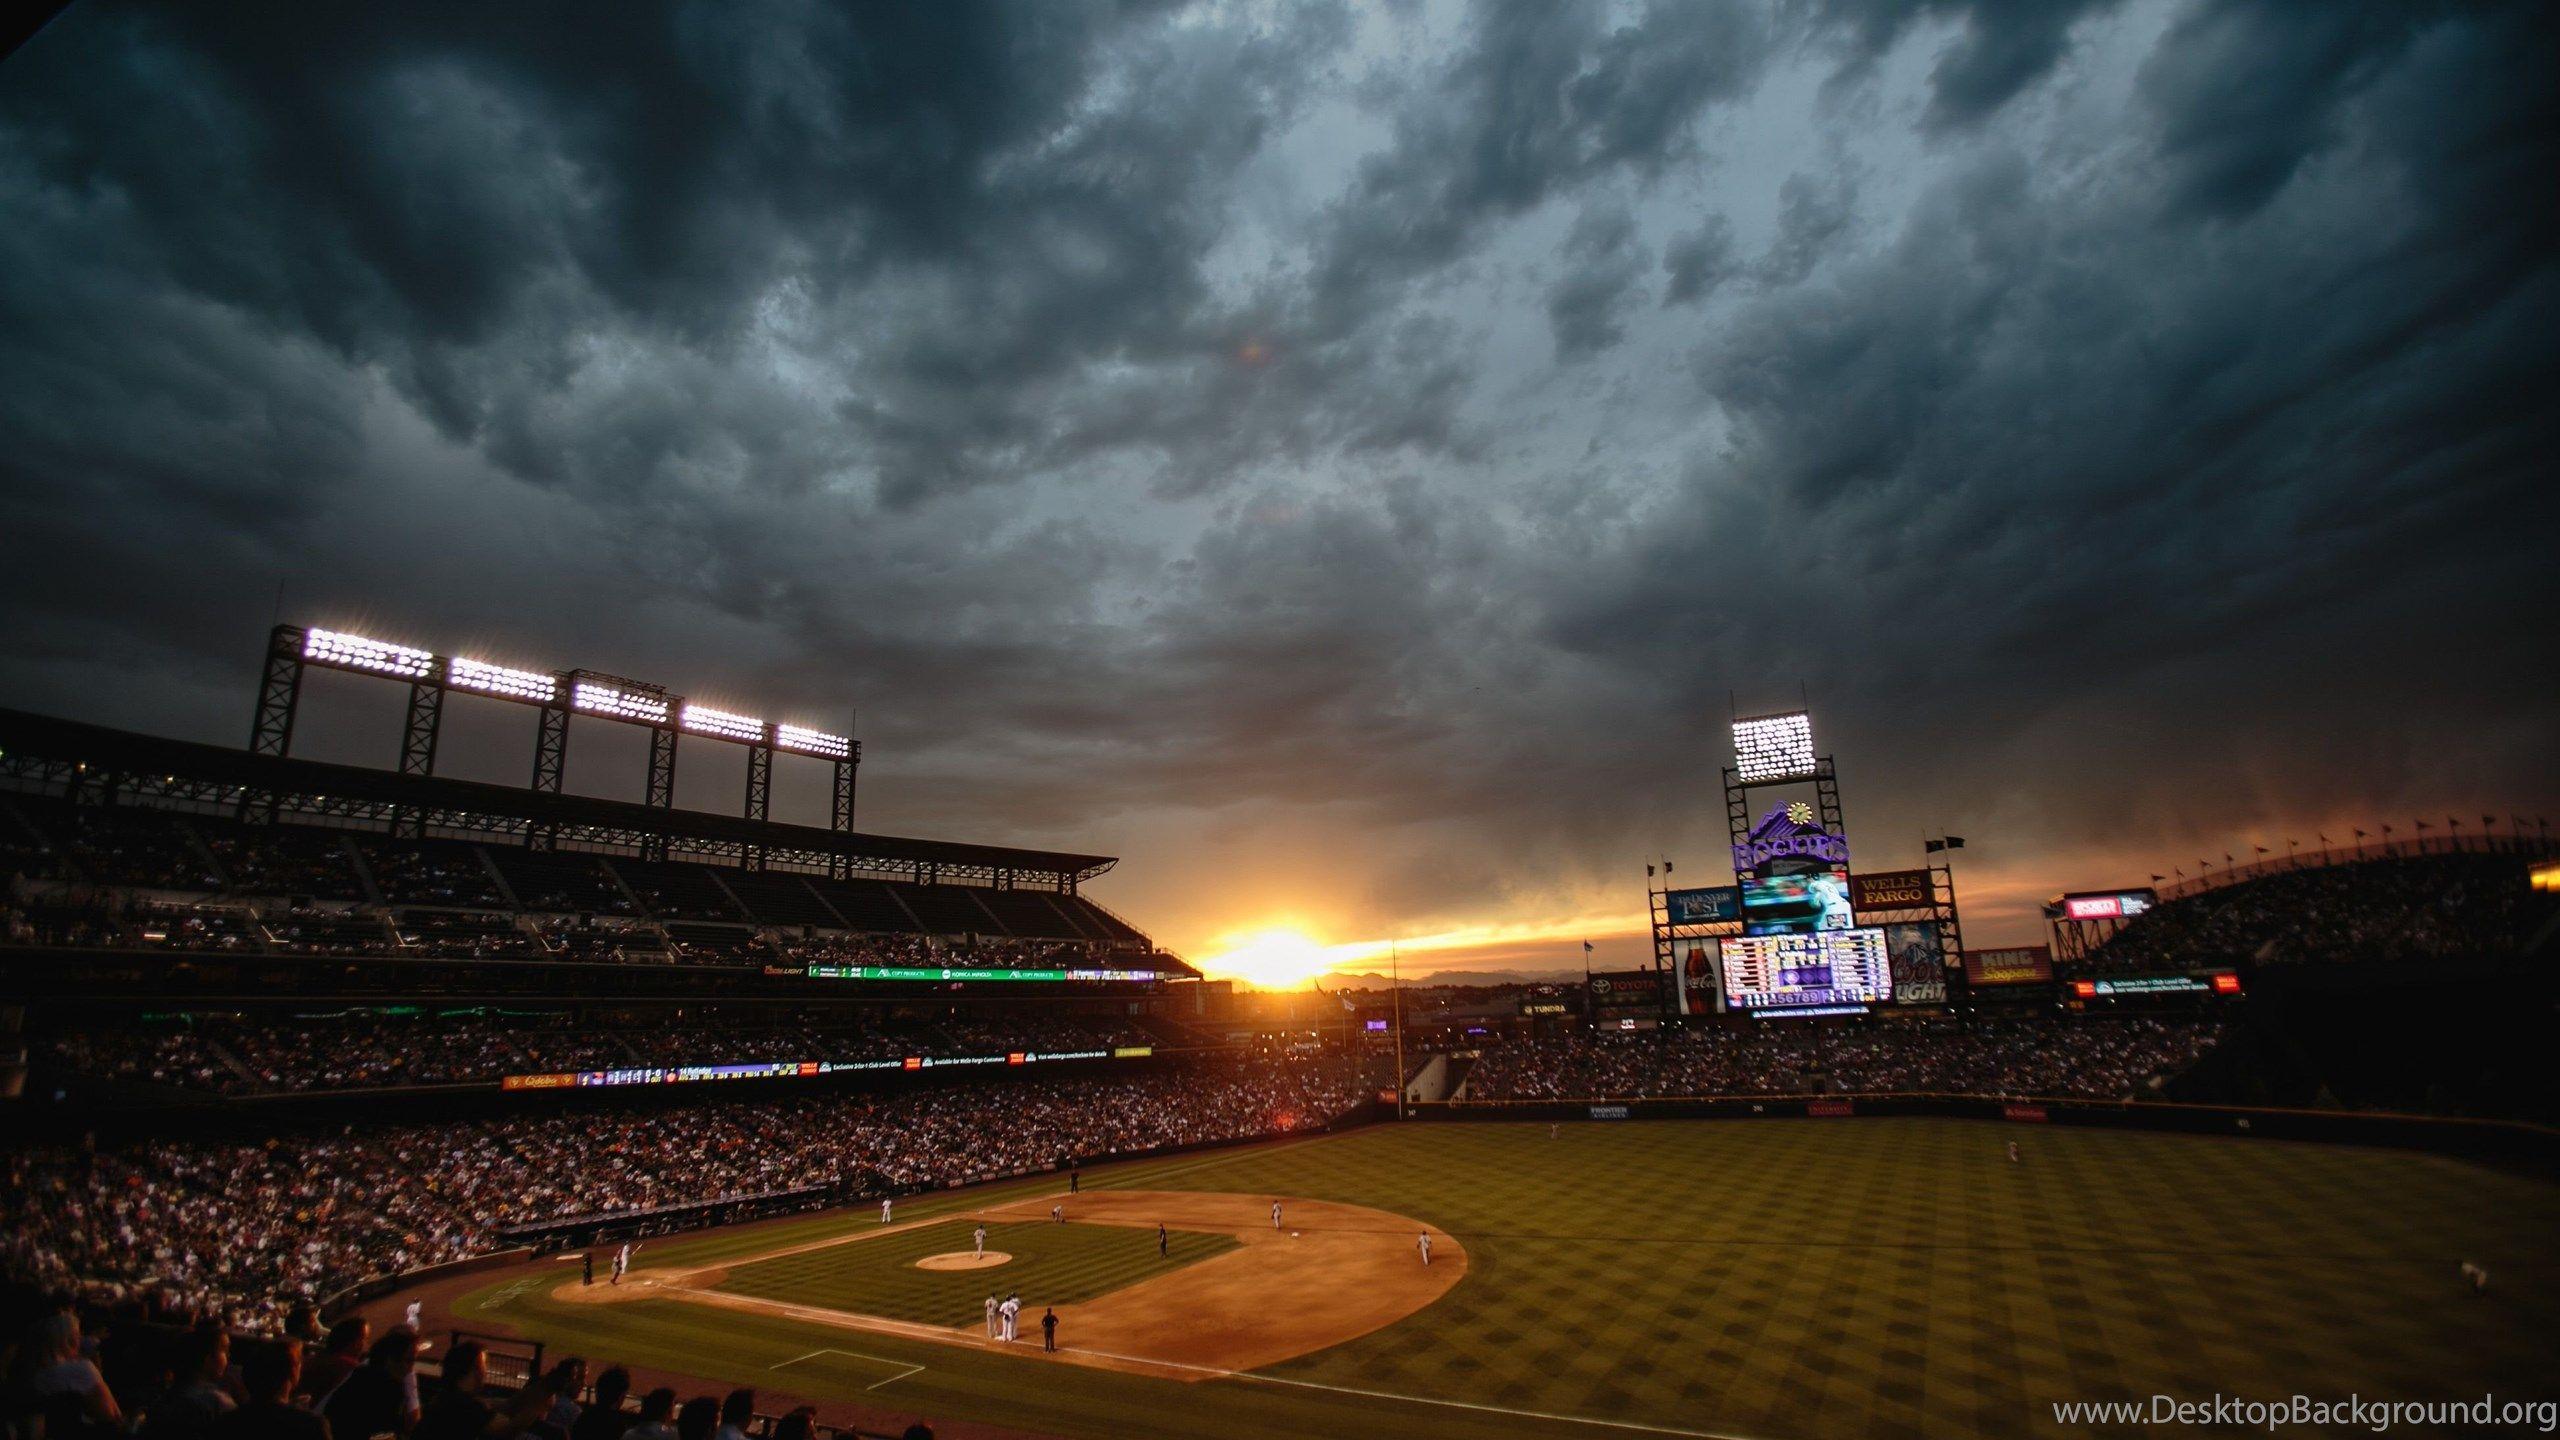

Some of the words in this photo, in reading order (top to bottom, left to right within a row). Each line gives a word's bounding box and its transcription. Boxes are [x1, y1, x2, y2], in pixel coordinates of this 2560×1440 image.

[1732, 836, 1850, 871] ROCKIES
[1861, 876, 1921, 890] WELLS
[1692, 893, 1730, 903] DENVER
[1865, 889, 1923, 904] FARGO
[1683, 901, 1718, 915] POST
[1980, 951, 2034, 967] KING
[1613, 980, 1657, 991] TOYOTA
[1896, 983, 1946, 1001] LIGHT
[1534, 1004, 1566, 1013] TUNDRA
[972, 1057, 983, 1065] Fargo
[525, 1075, 557, 1086] Qdoba
[1590, 1106, 1627, 1114] FRONTIER
